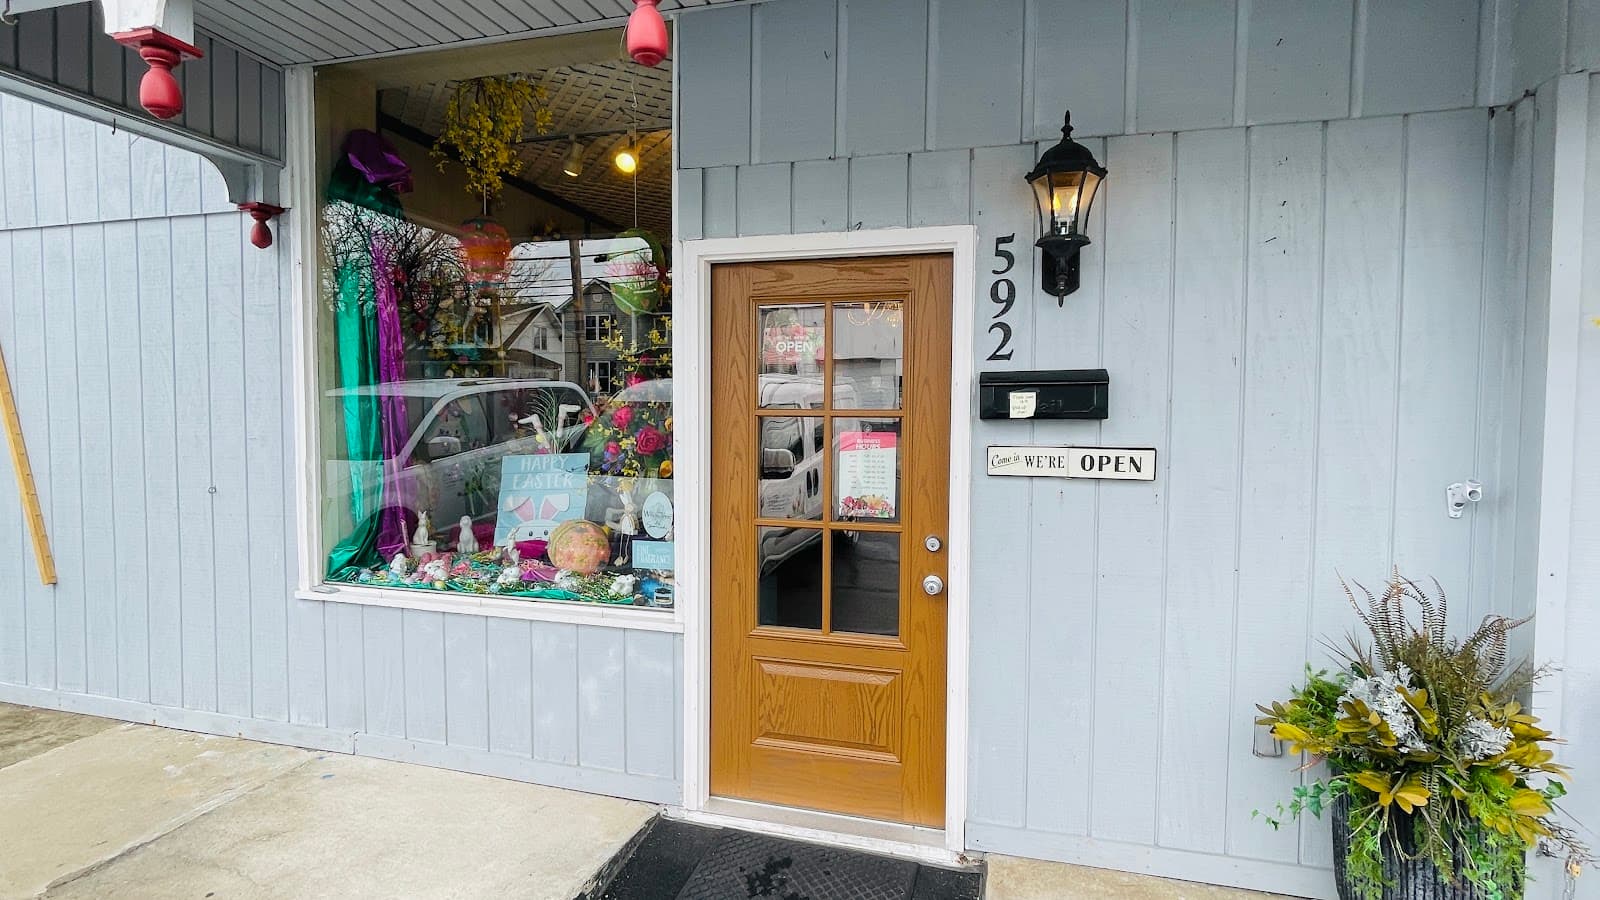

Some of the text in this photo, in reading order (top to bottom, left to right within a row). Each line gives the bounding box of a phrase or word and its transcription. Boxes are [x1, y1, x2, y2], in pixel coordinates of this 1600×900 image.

[986, 232, 1016, 361] 592
[775, 341, 814, 353] OPEN
[521, 455, 569, 472] HAPPY
[991, 452, 1143, 473] Come in WE'RE OPEN
[512, 472, 574, 490] EASTER
